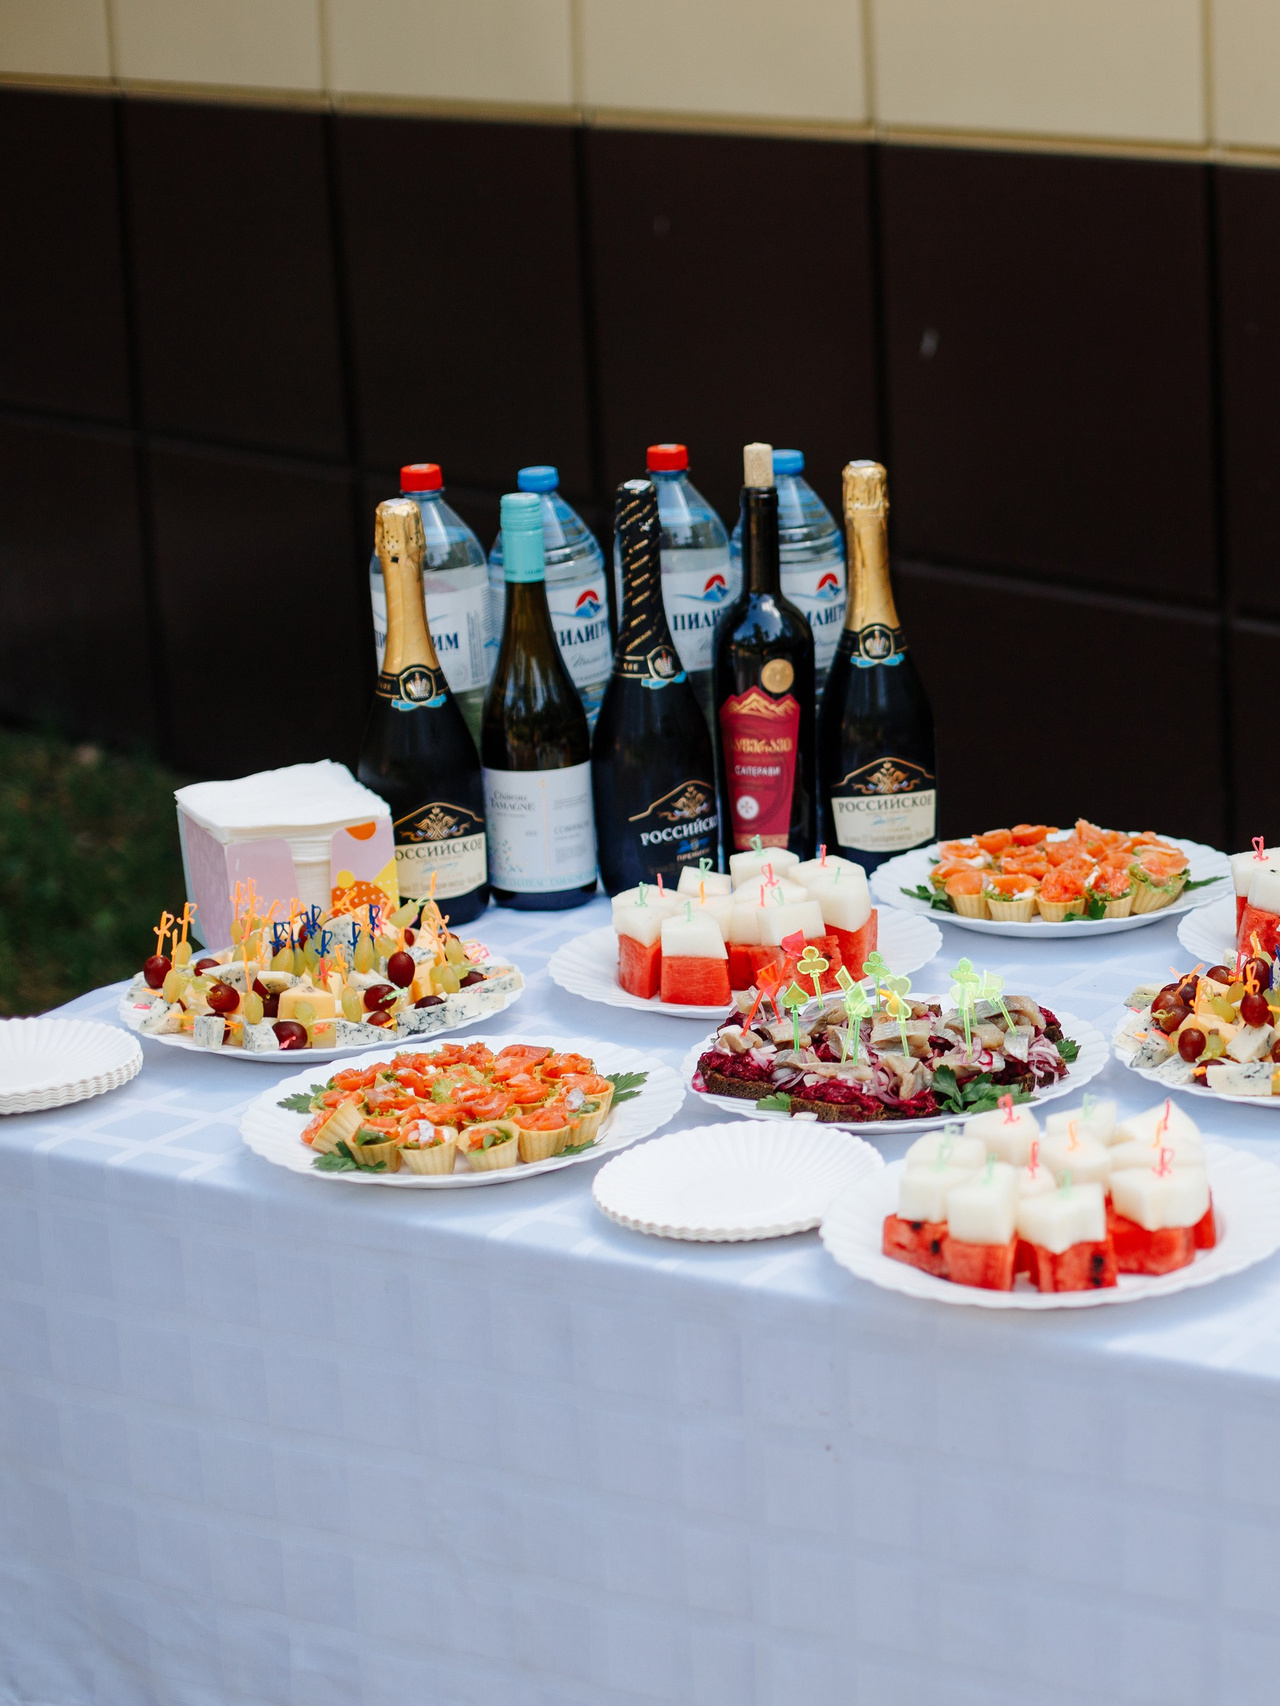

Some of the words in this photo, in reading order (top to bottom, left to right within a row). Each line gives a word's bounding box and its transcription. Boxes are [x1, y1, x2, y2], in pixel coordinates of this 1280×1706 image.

[734, 764, 781, 777] САПЕРАВИ
[837, 794, 933, 813] РОССИЙСКОЕ
[640, 814, 718, 847] РОССИЙСК
[395, 838, 483, 861] ОССИЙСКОЕ
